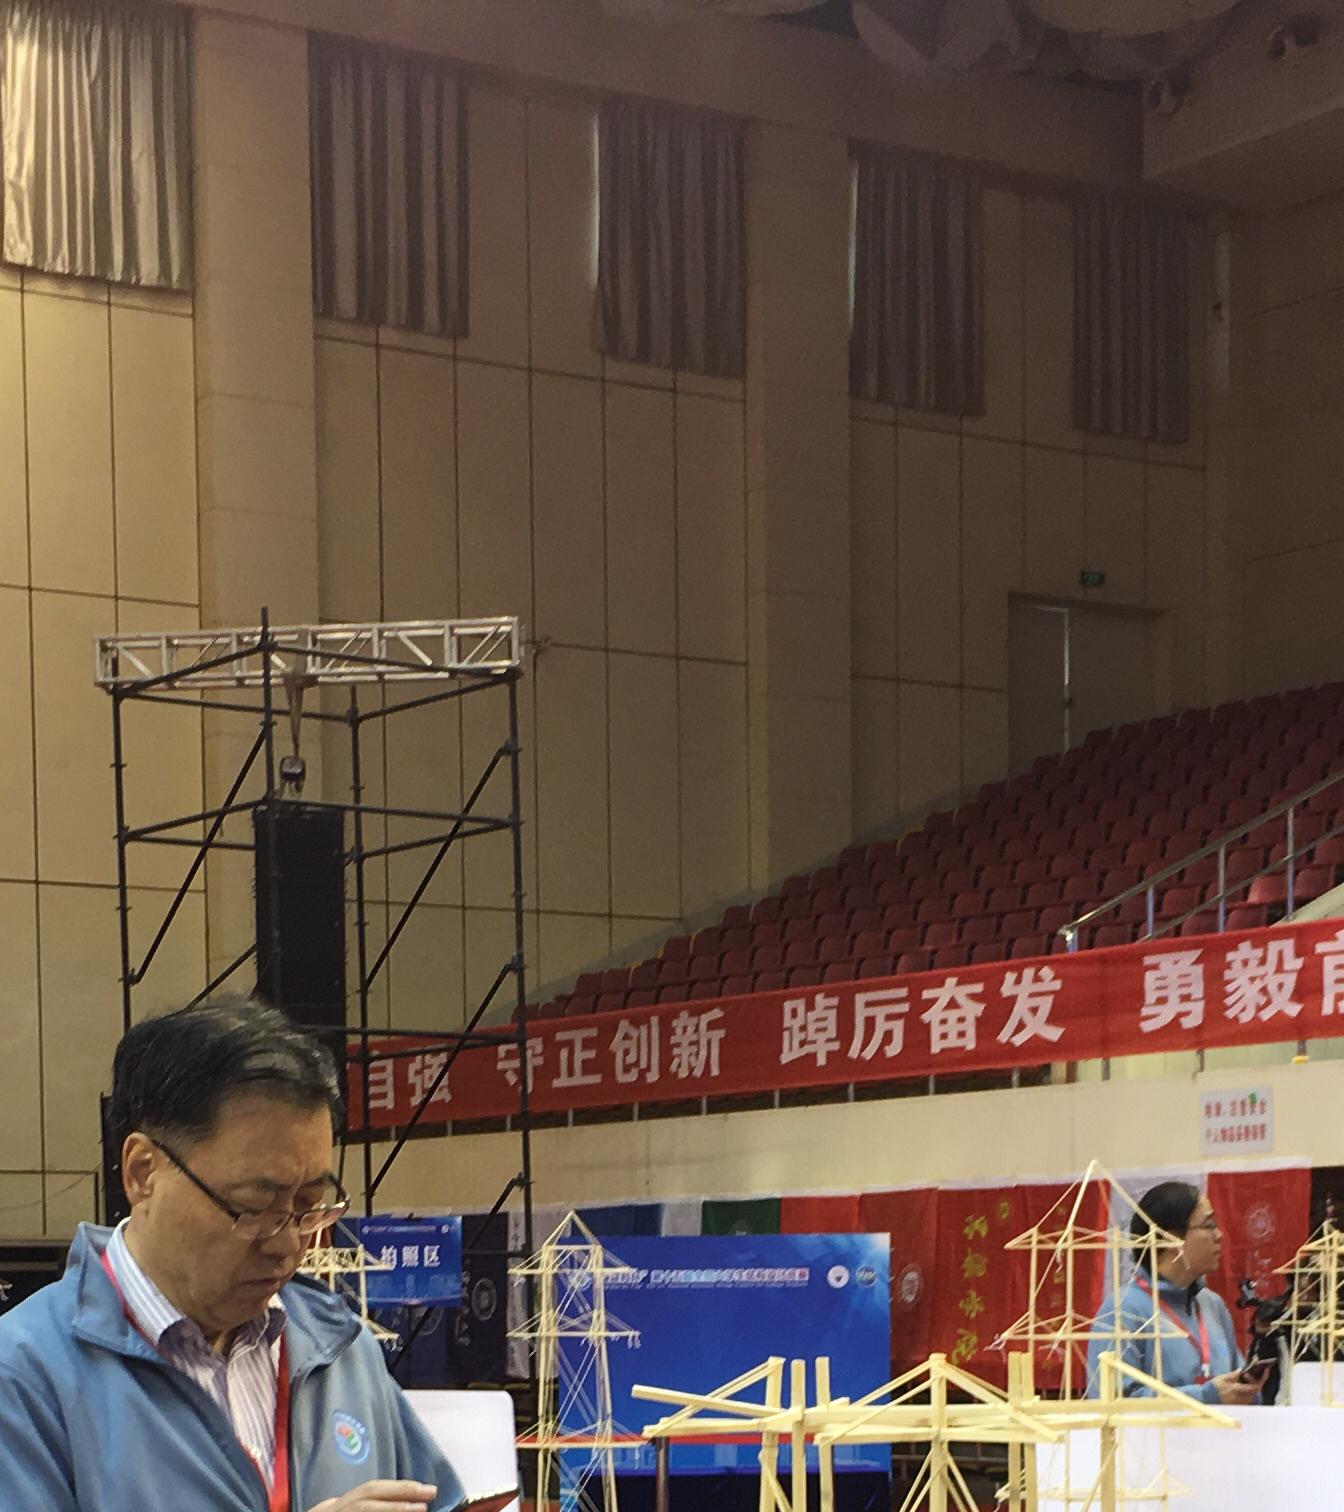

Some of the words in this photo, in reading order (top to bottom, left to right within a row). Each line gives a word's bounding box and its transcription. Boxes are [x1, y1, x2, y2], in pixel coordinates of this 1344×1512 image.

[496, 1007, 727, 1093] 守正创新
[779, 966, 1066, 1066] 踔厉奋发
